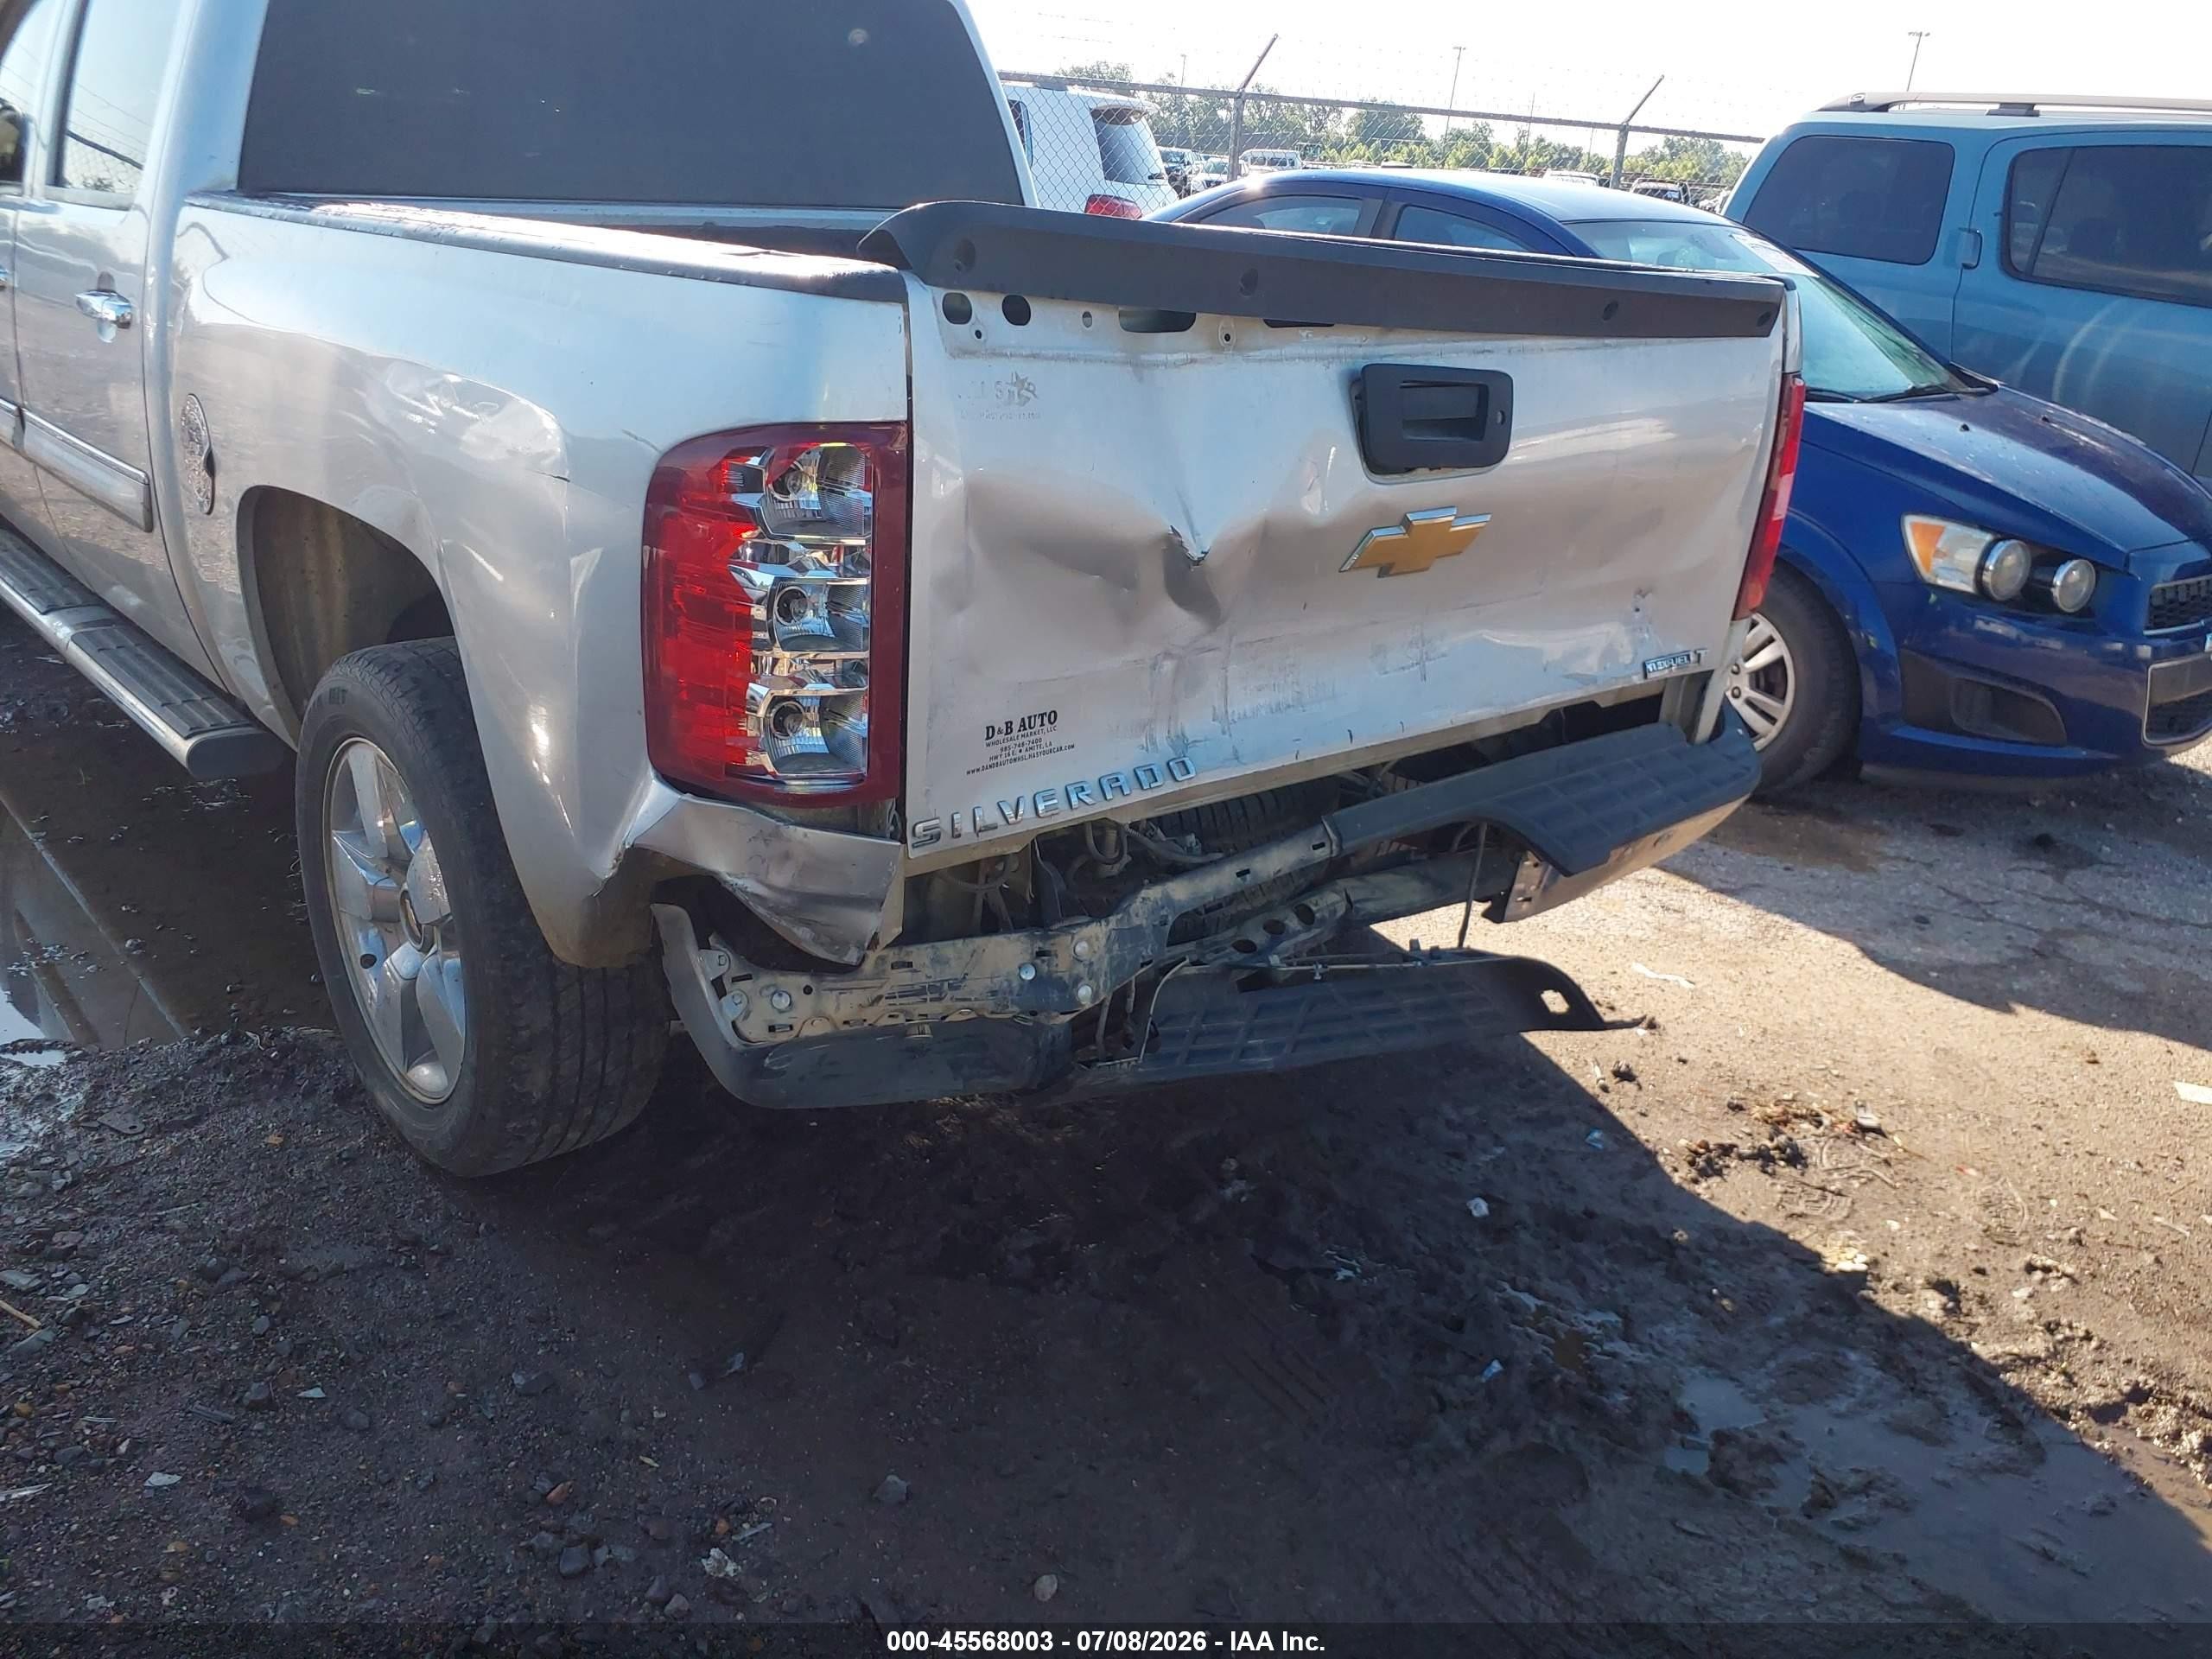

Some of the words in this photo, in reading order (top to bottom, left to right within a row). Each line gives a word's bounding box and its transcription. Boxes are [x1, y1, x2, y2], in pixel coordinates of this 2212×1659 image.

[1017, 709, 1058, 733] AUTO
[985, 735, 1020, 747] WHOLESALE
[1020, 728, 1046, 740] MARKET,
[1046, 725, 1057, 734] LLC
[966, 743, 1075, 775] WWW.DANDBAUTOWHSL.HASYOURCAR.COM
[989, 752, 1003, 762] HWY
[1004, 750, 1011, 759] 16
[1025, 741, 1045, 753] AMITE,
[912, 755, 1198, 849] SILVERADO
